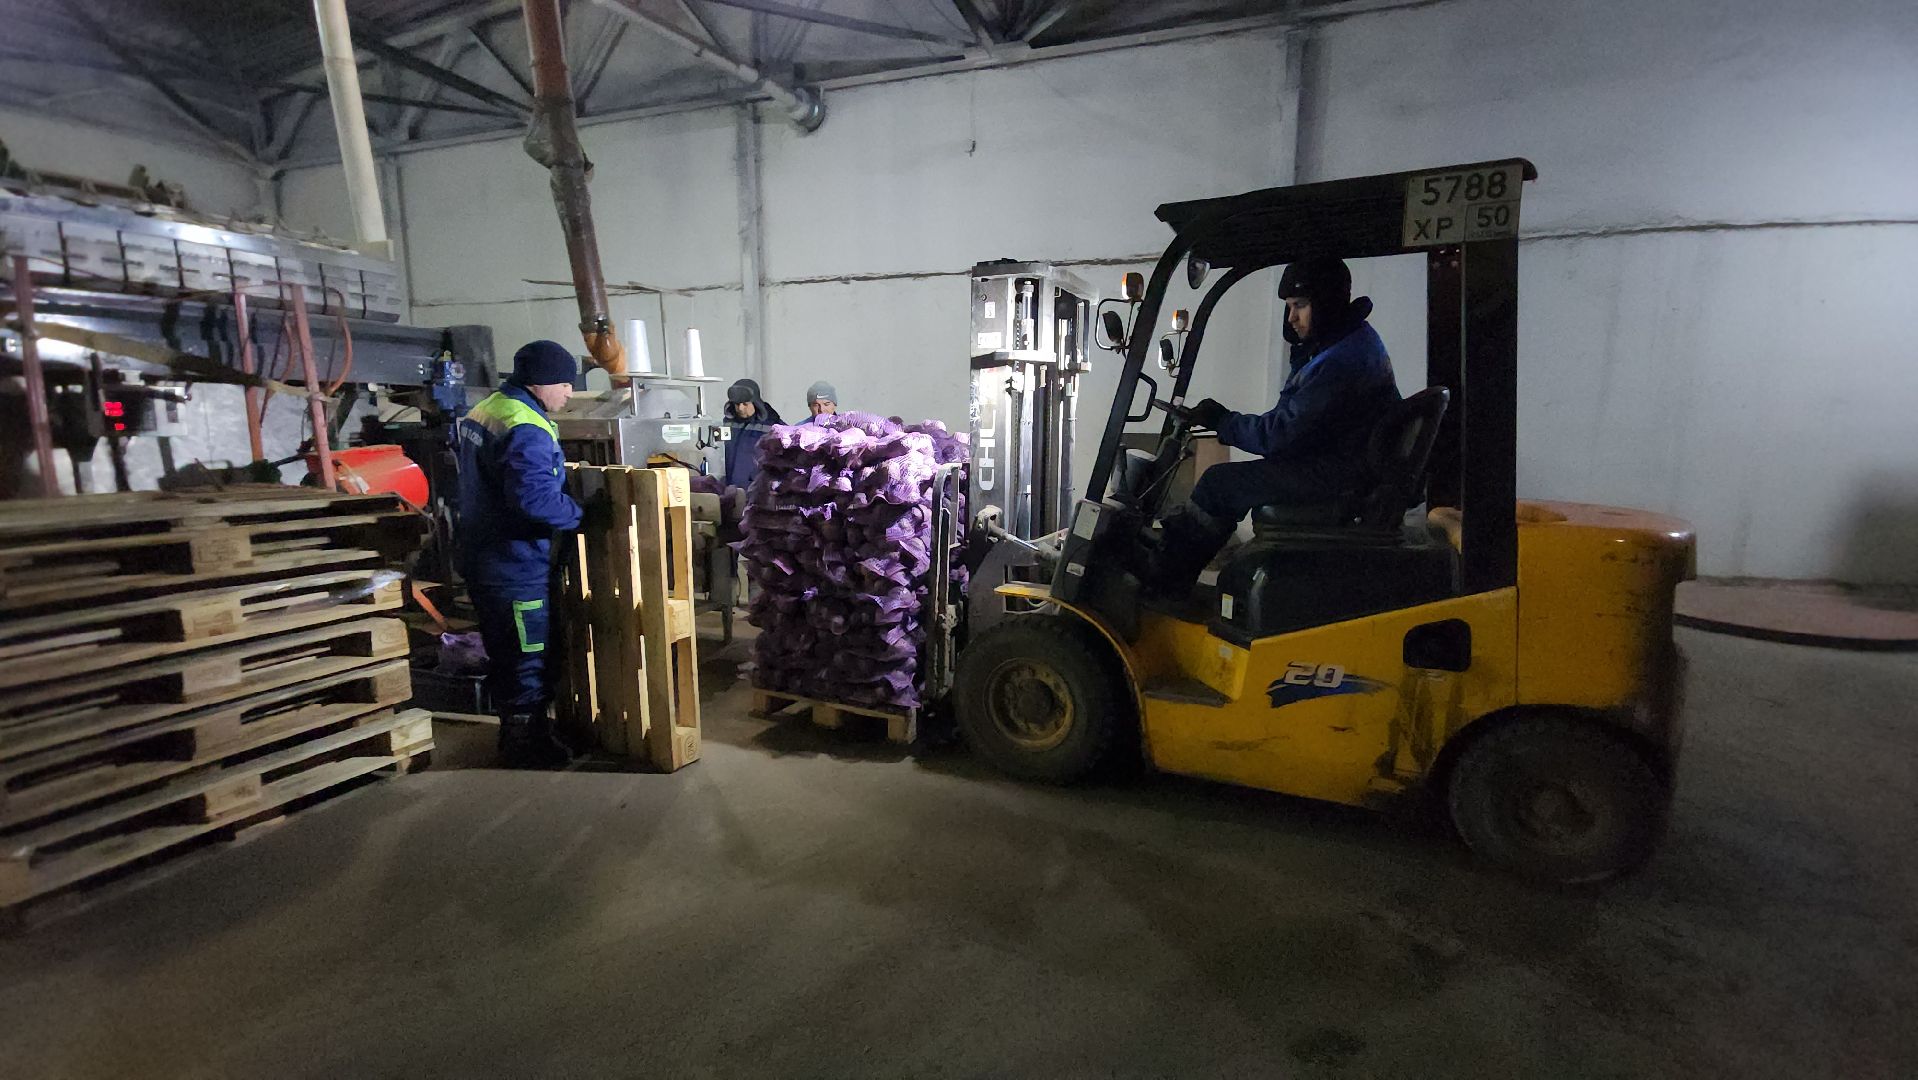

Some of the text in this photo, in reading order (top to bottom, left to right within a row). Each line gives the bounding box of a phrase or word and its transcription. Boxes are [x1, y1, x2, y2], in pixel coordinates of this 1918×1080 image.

[1421, 170, 1508, 206] 5788
[1477, 204, 1510, 228] 50
[978, 408, 997, 491] CHL
